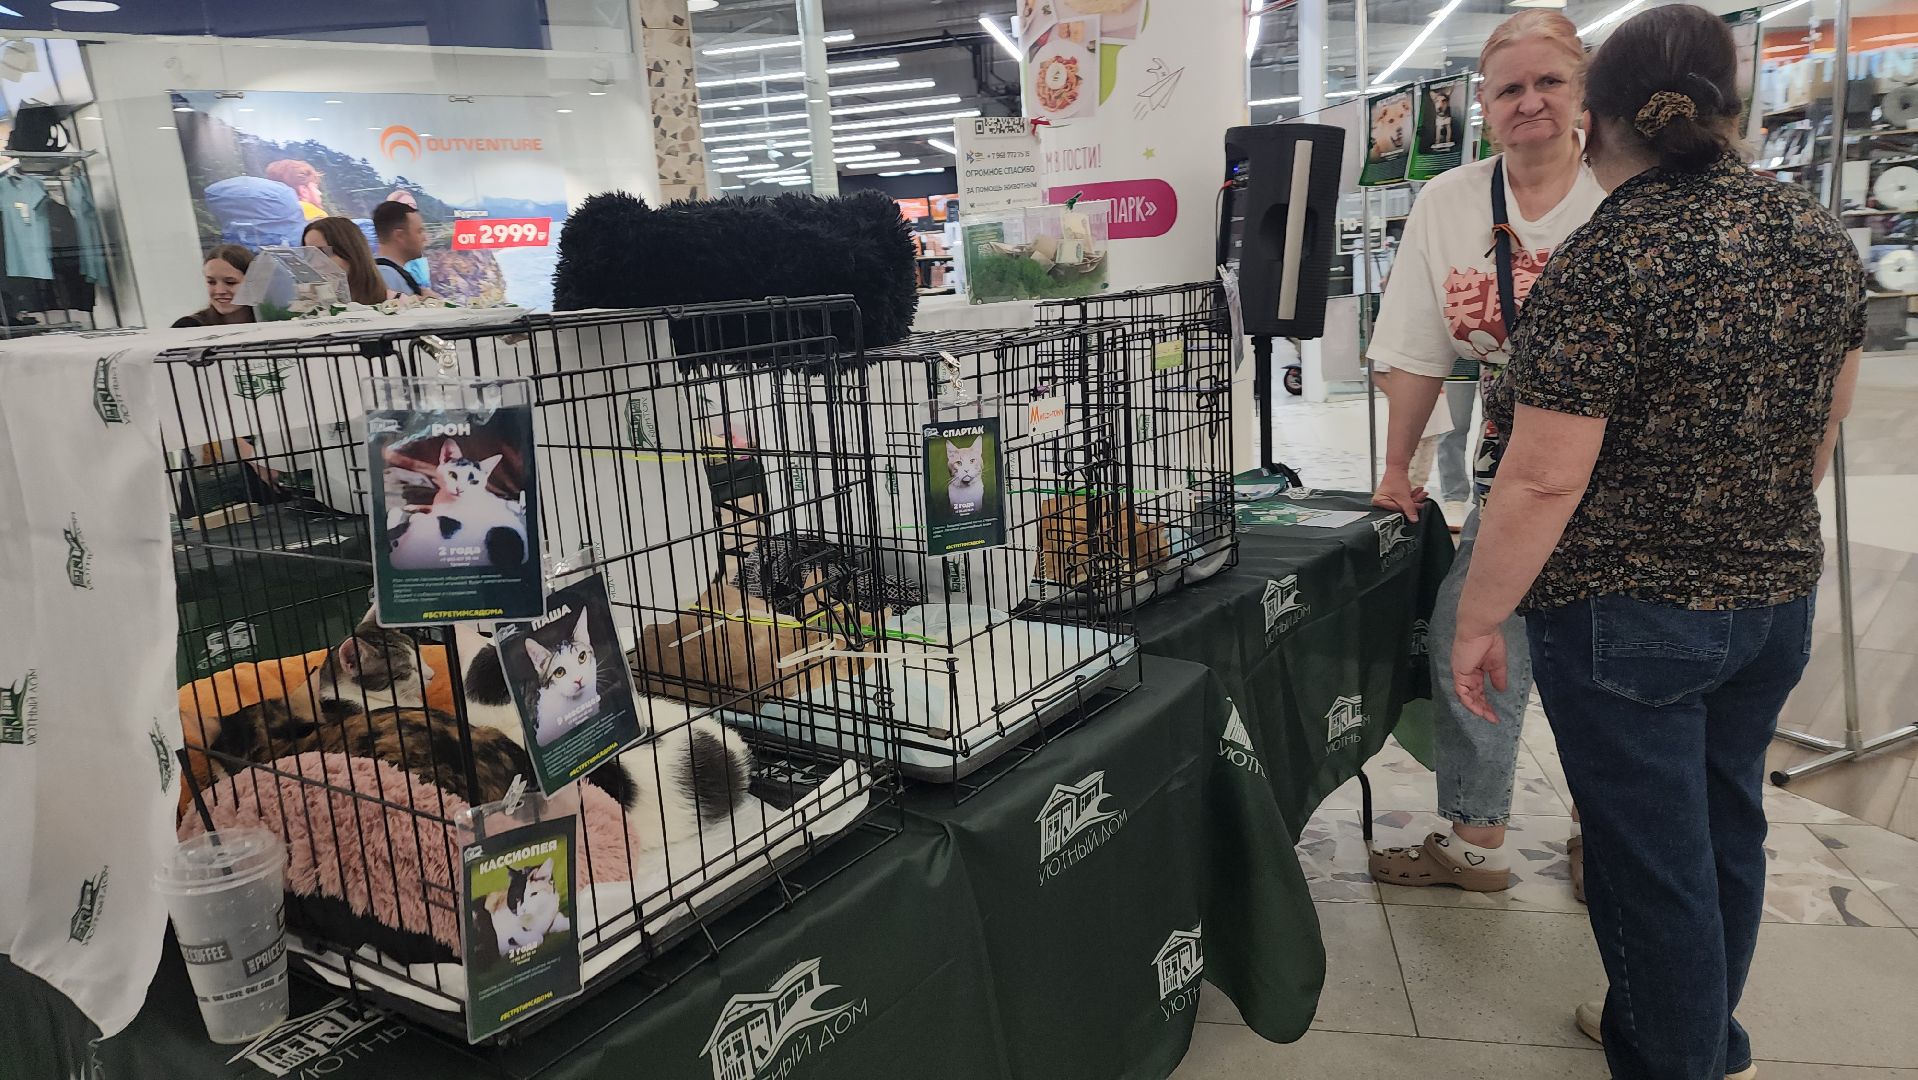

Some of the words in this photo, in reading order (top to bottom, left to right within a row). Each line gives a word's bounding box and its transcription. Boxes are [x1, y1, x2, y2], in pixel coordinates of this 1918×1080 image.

[426, 137, 543, 152] OUTVENTURE
[1063, 144, 1102, 171] ГОСТИ!
[965, 167, 1003, 177] ОГРОМНОЕ
[1004, 165, 1036, 174] СПАСИБО
[431, 422, 471, 437] РОН
[942, 424, 985, 438] СПАРТАК
[438, 546, 448, 556] 2
[450, 546, 481, 556] года
[1038, 828, 1100, 887] УЮТНЫЙ
[1100, 808, 1128, 846] ДОМ
[480, 839, 558, 875] КАССИОПЕЯ
[508, 949, 515, 959] 2
[818, 997, 868, 1053] ДОМ
